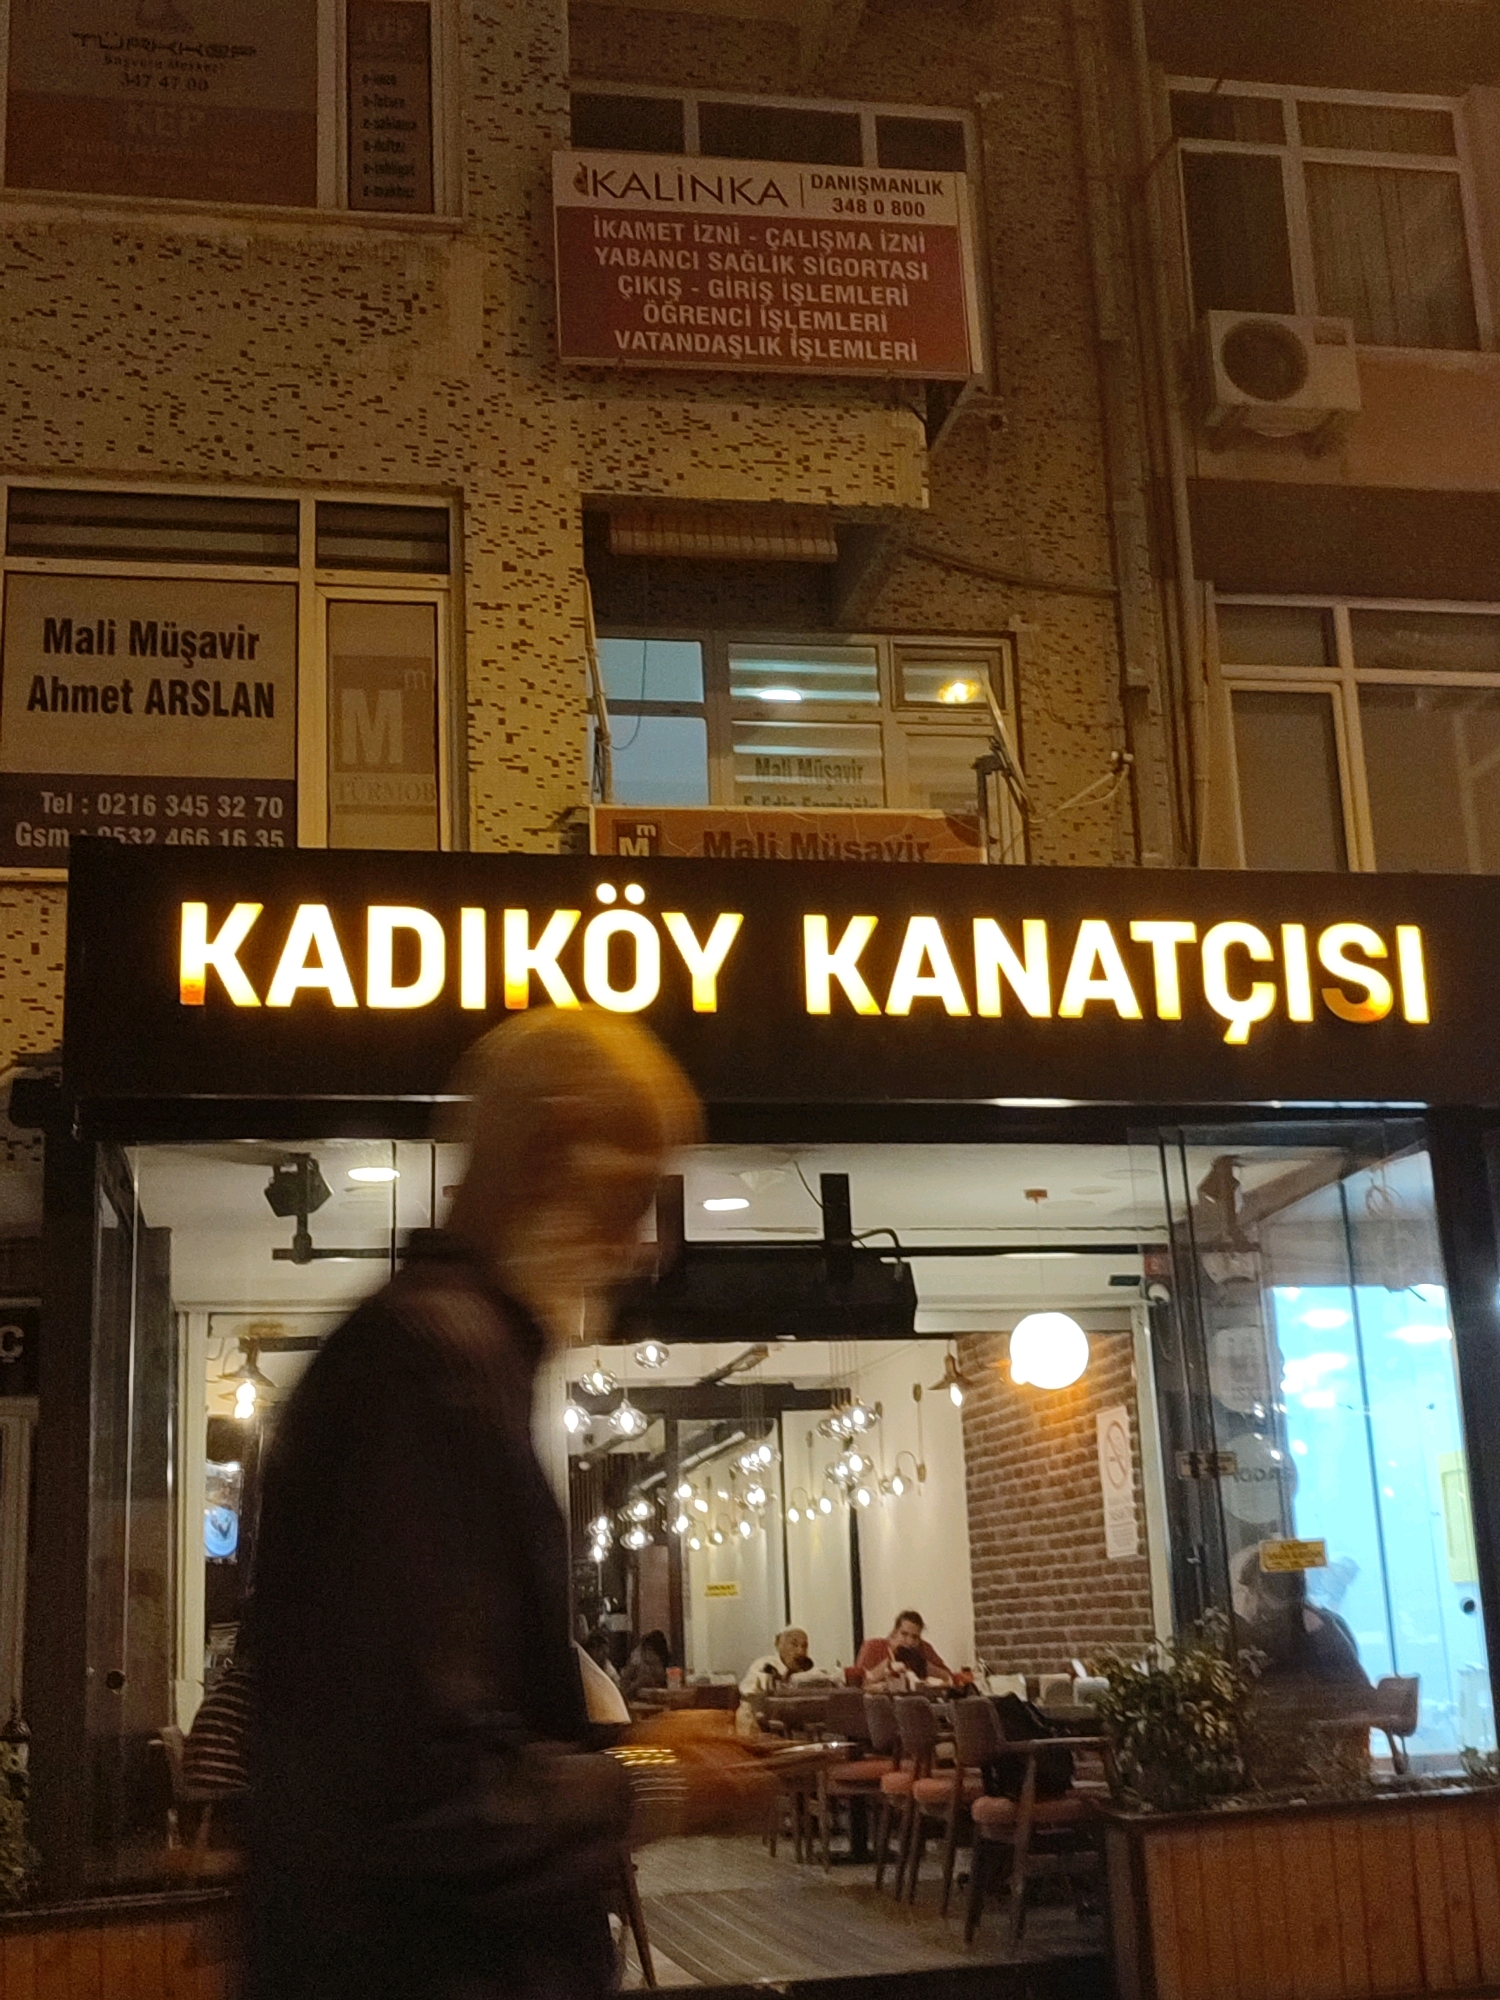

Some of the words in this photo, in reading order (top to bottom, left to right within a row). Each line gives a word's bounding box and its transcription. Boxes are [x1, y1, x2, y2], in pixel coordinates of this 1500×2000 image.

[592, 165, 789, 207] KALİNKA
[810, 173, 944, 197] DANIŞMANLIK
[832, 197, 866, 215] 348
[874, 199, 885, 216] 0
[891, 201, 926, 218] 800
[593, 215, 683, 242] İKAMET
[693, 219, 741, 245] İZNİ
[765, 227, 873, 252] ÇALIŞMA
[880, 229, 926, 254] İZNİ
[594, 246, 699, 270] YABANCI
[708, 249, 794, 275] SAĞLIK
[803, 253, 929, 281] SİGORTASI
[617, 275, 683, 301] ÇIKIŞ
[708, 276, 773, 303] GİRİŞ
[782, 278, 909, 307] İŞLEMLERİ
[643, 299, 752, 328] ÖĞRENCİ
[760, 306, 889, 333] İŞLEMLERİ
[613, 330, 783, 360] VATANDAŞLIK
[791, 332, 918, 362] İŞLEMLERİ
[43, 617, 116, 656] Mali
[128, 618, 260, 669] Müşavir
[27, 674, 134, 715] Ahmet
[145, 679, 275, 719] ARSLAN
[340, 688, 403, 764] M
[755, 757, 793, 782] Mali
[797, 757, 865, 790] Müşavir
[41, 791, 73, 814] Tel
[81, 798, 89, 815] :
[97, 793, 157, 817] 0216
[164, 795, 209, 818] 345
[216, 796, 246, 818] 32
[254, 797, 284, 819] 70
[15, 822, 71, 848] Gsm
[164, 828, 210, 846] 466
[219, 829, 246, 846] 16
[254, 829, 285, 848] 35
[703, 830, 777, 860] Mali
[179, 882, 744, 1013] KADIKÖY
[803, 913, 1430, 1044] KANATÇISI
